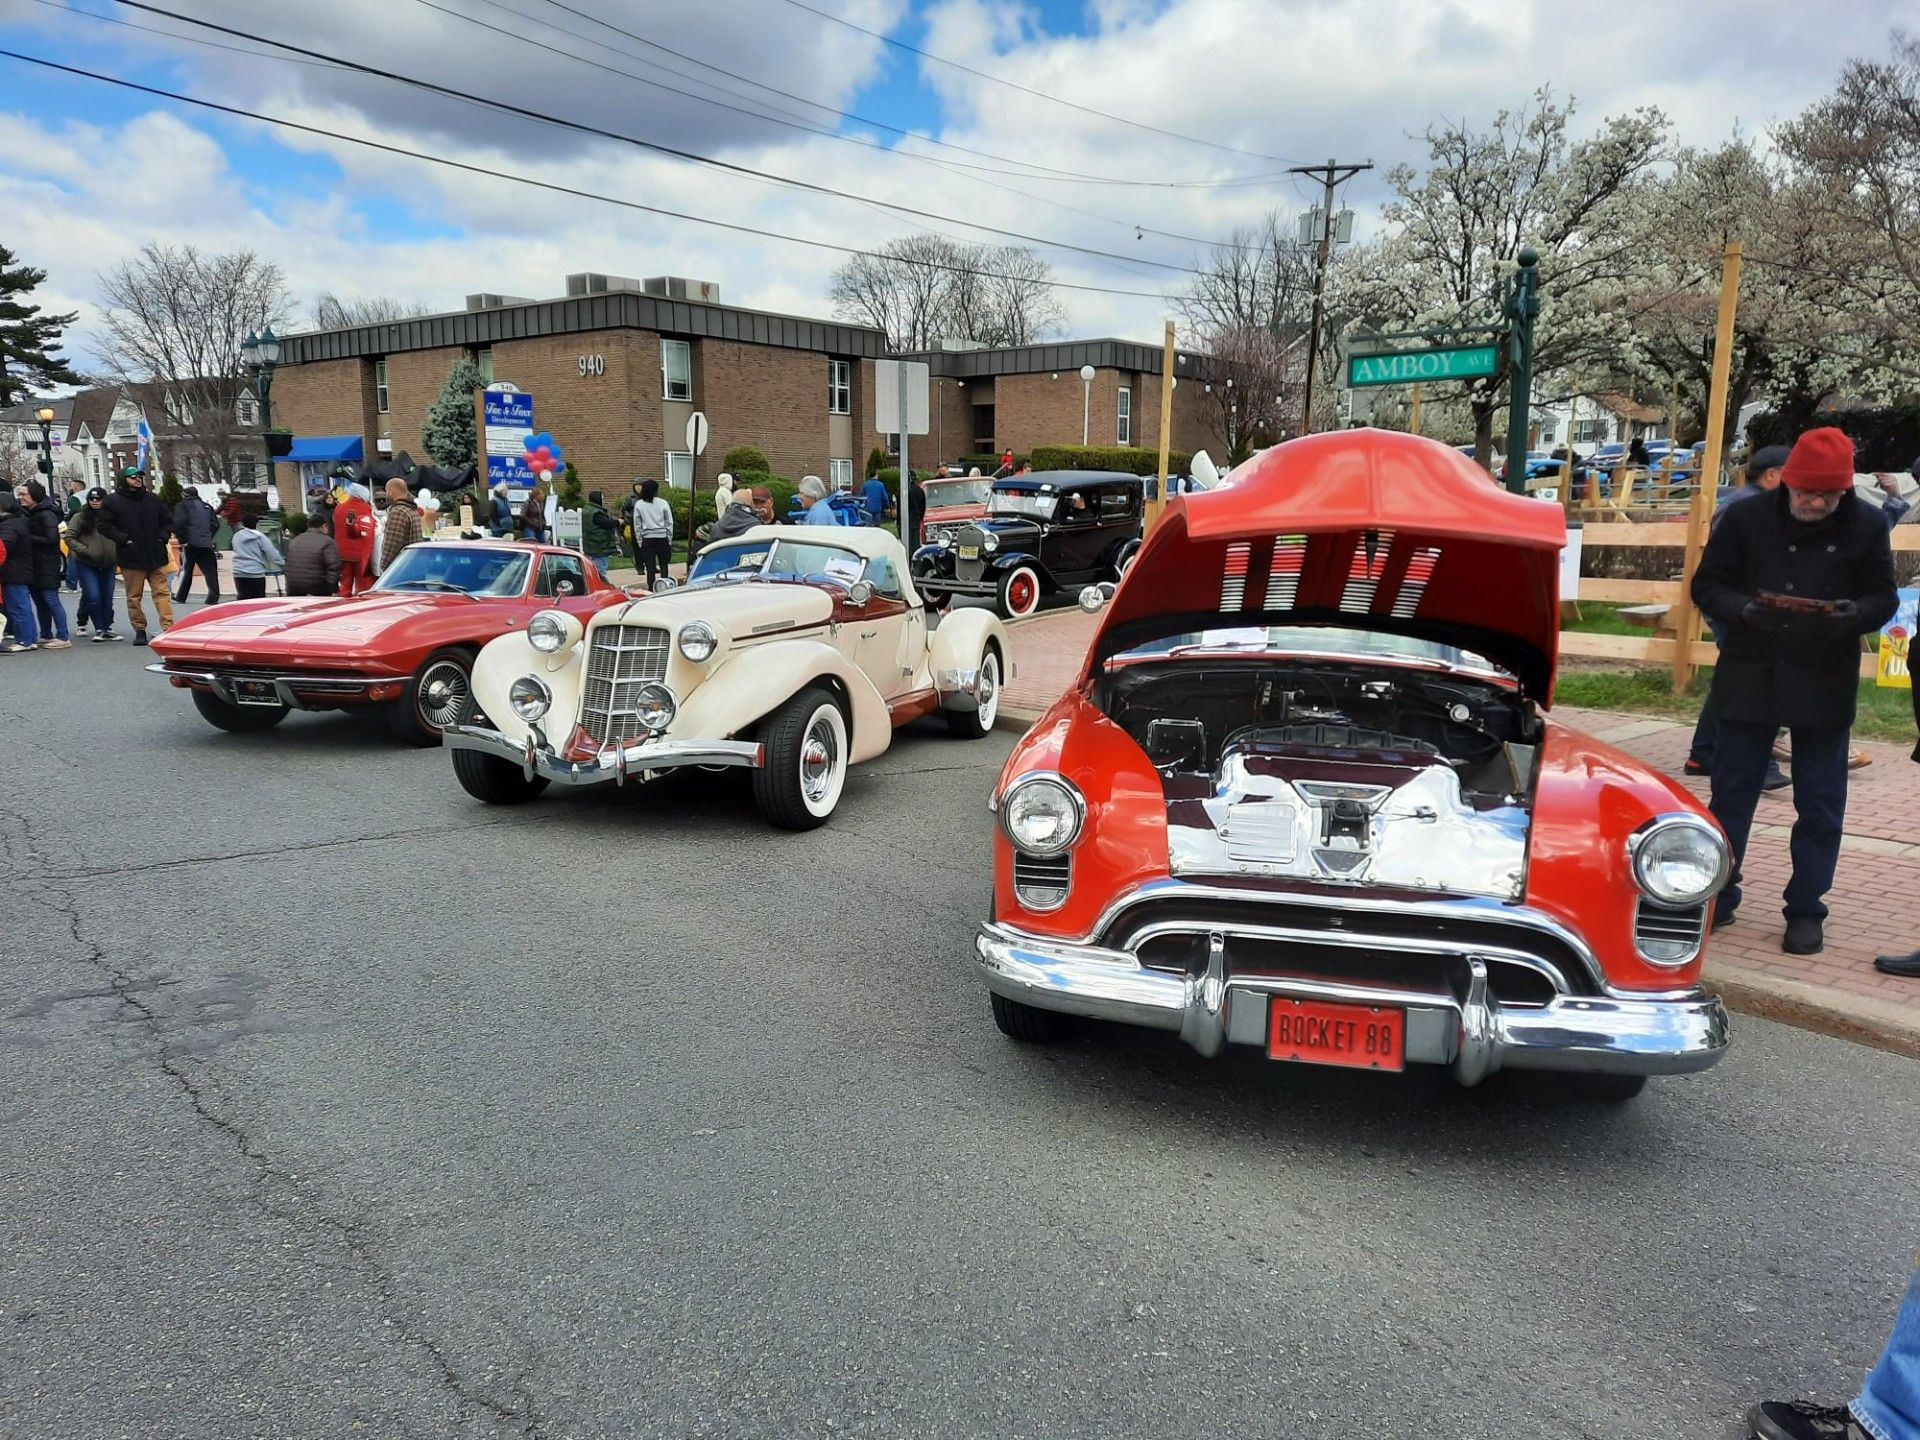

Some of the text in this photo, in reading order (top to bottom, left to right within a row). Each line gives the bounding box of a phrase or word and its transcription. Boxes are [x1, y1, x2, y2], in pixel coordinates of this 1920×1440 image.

[578, 354, 604, 376] 940
[1355, 352, 1492, 380] AMBOY AVE
[1280, 1014, 1391, 1055] ROCKET 88
